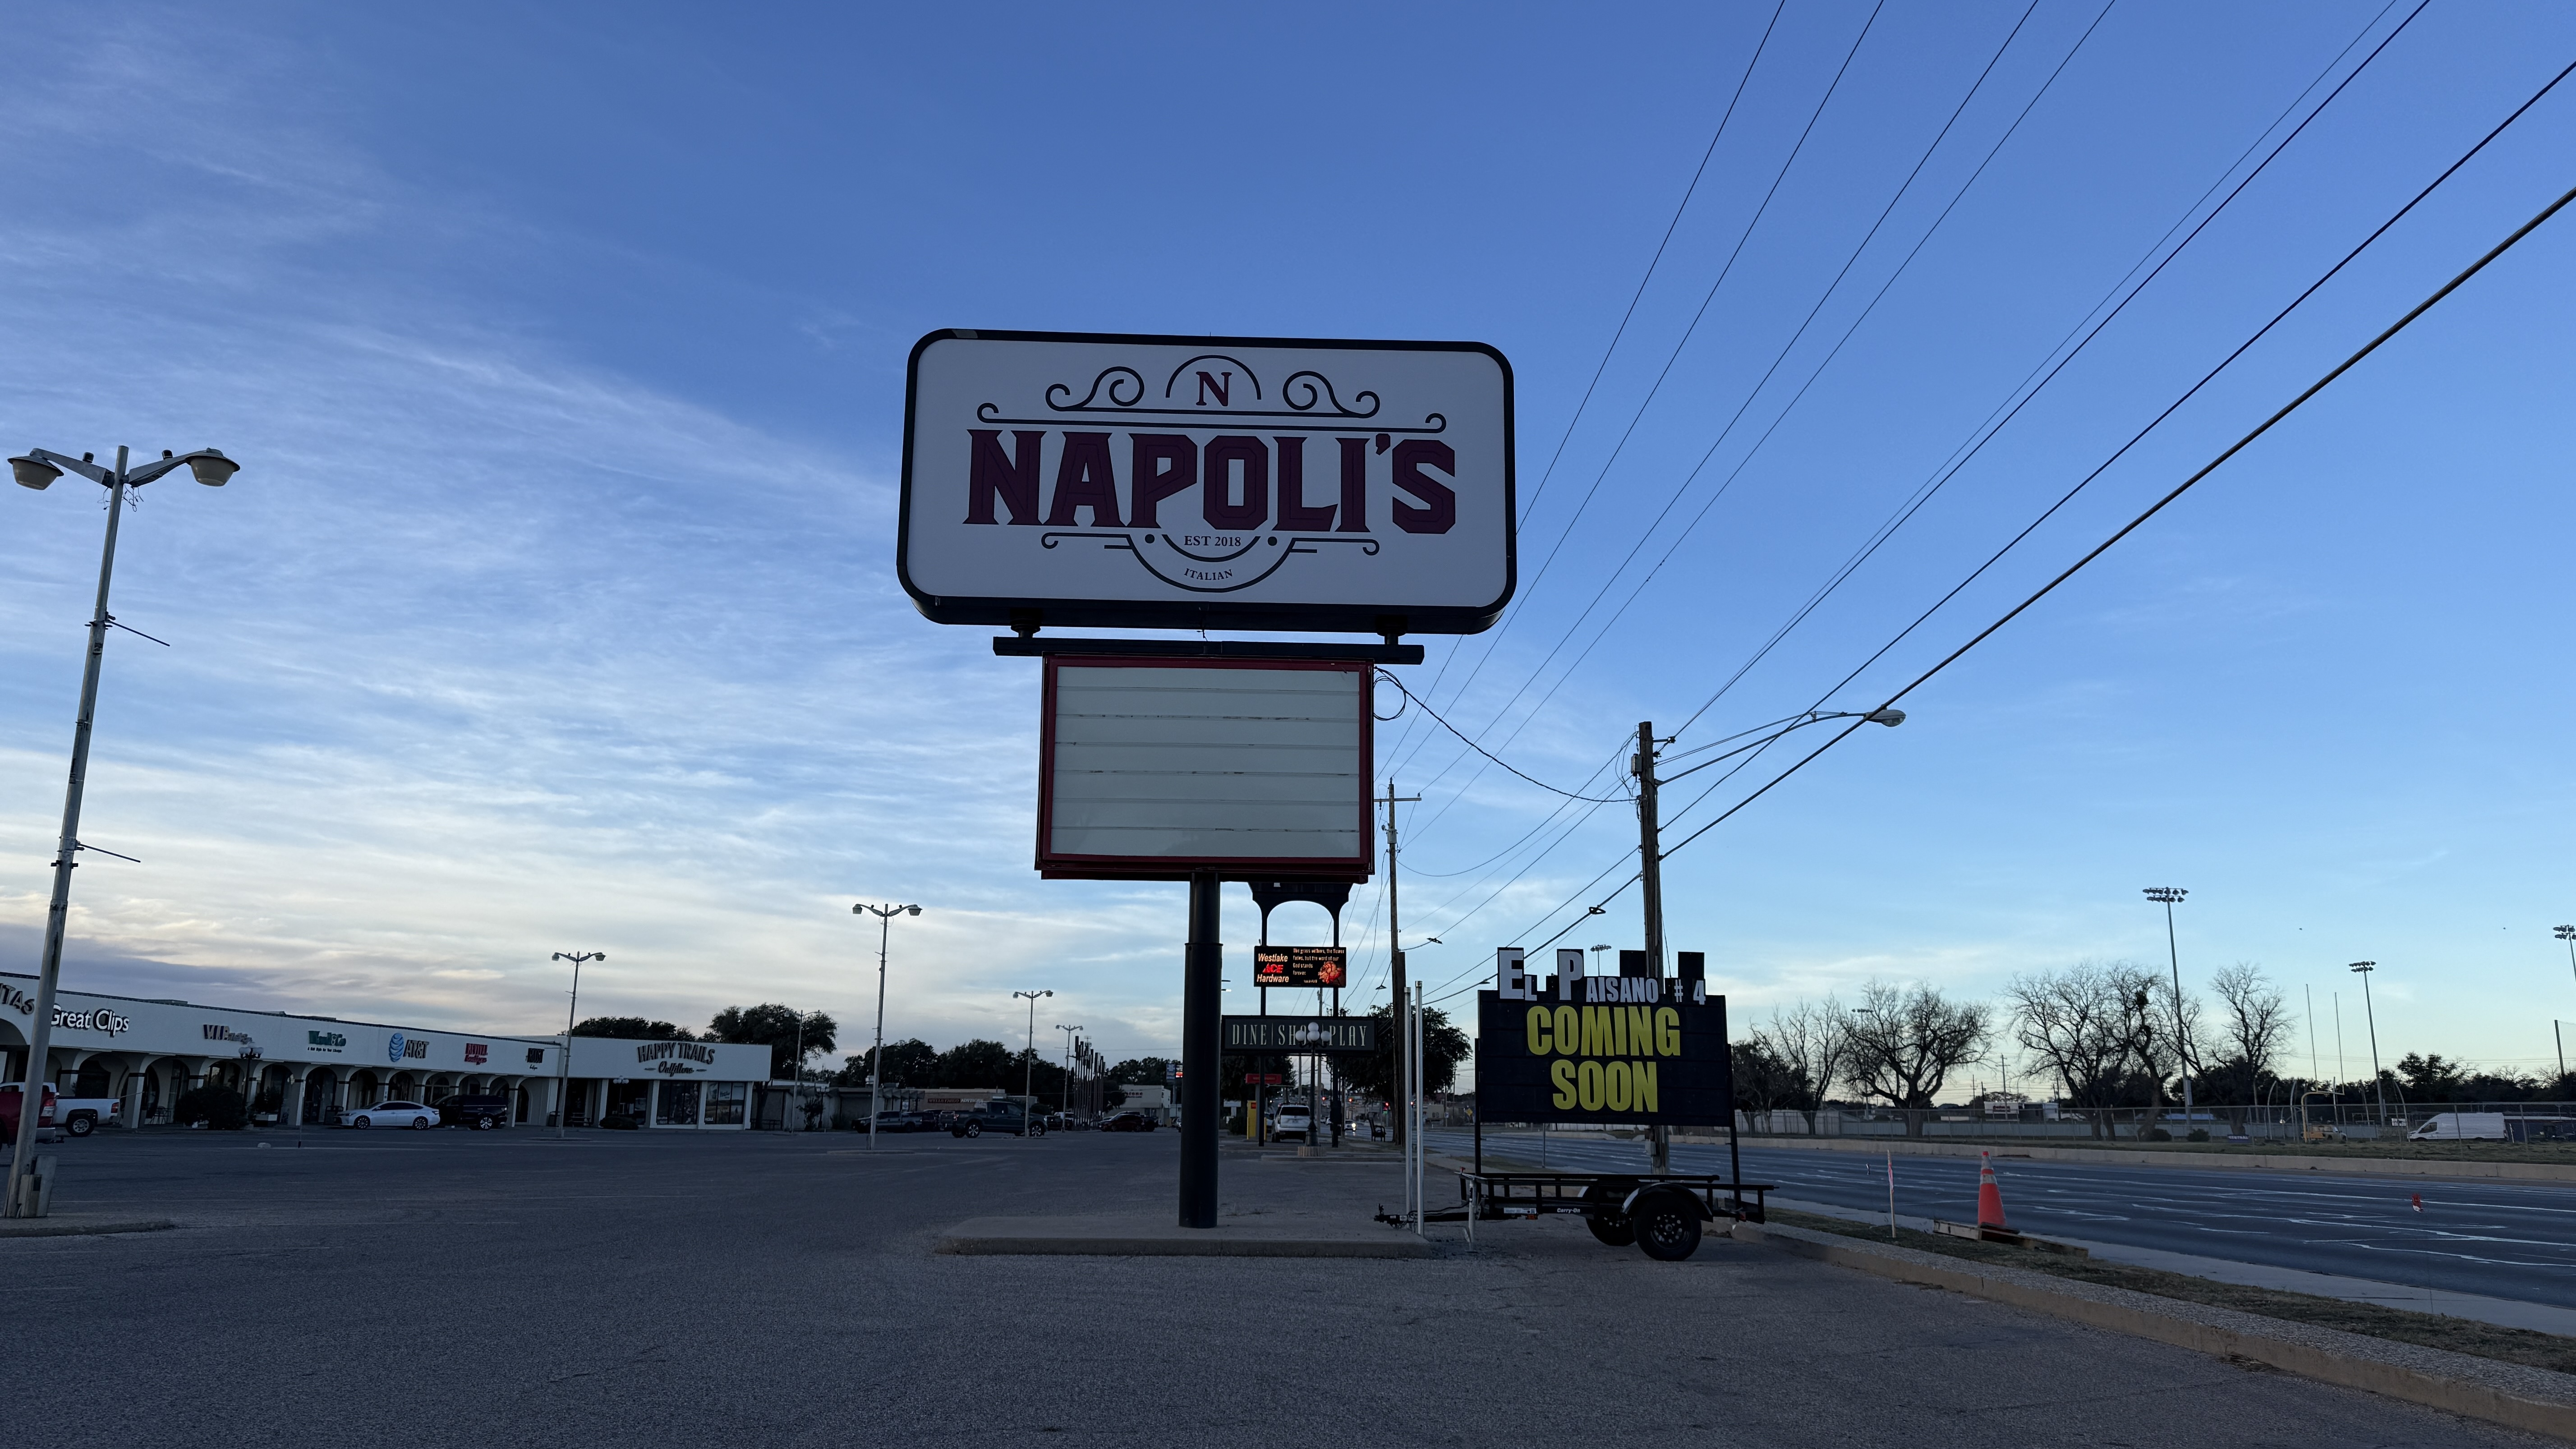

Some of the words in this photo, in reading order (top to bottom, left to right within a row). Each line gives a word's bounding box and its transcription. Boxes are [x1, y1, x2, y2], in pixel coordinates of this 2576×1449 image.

[1196, 371, 1232, 407] N
[962, 429, 1456, 534] NAPOLI'S
[1184, 536, 1211, 546] EST
[1214, 537, 1241, 546] 2018
[1184, 568, 1233, 580] ITALIAN
[1258, 953, 1288, 962] Westlake
[1263, 962, 1283, 973] ACE
[1256, 974, 1289, 983] Hardware
[51, 1004, 91, 1029] Great
[95, 1009, 130, 1037] Clips
[1527, 1006, 1680, 1056] COMING
[1233, 1025, 1267, 1045] DINE
[1278, 1025, 1307, 1046] SHO
[1329, 1026, 1367, 1046] PLAY
[403, 1040, 429, 1058] AT&T
[638, 1042, 676, 1063] HAPPY
[678, 1043, 715, 1064] TRAILS
[1550, 1059, 1658, 1112] SOON
